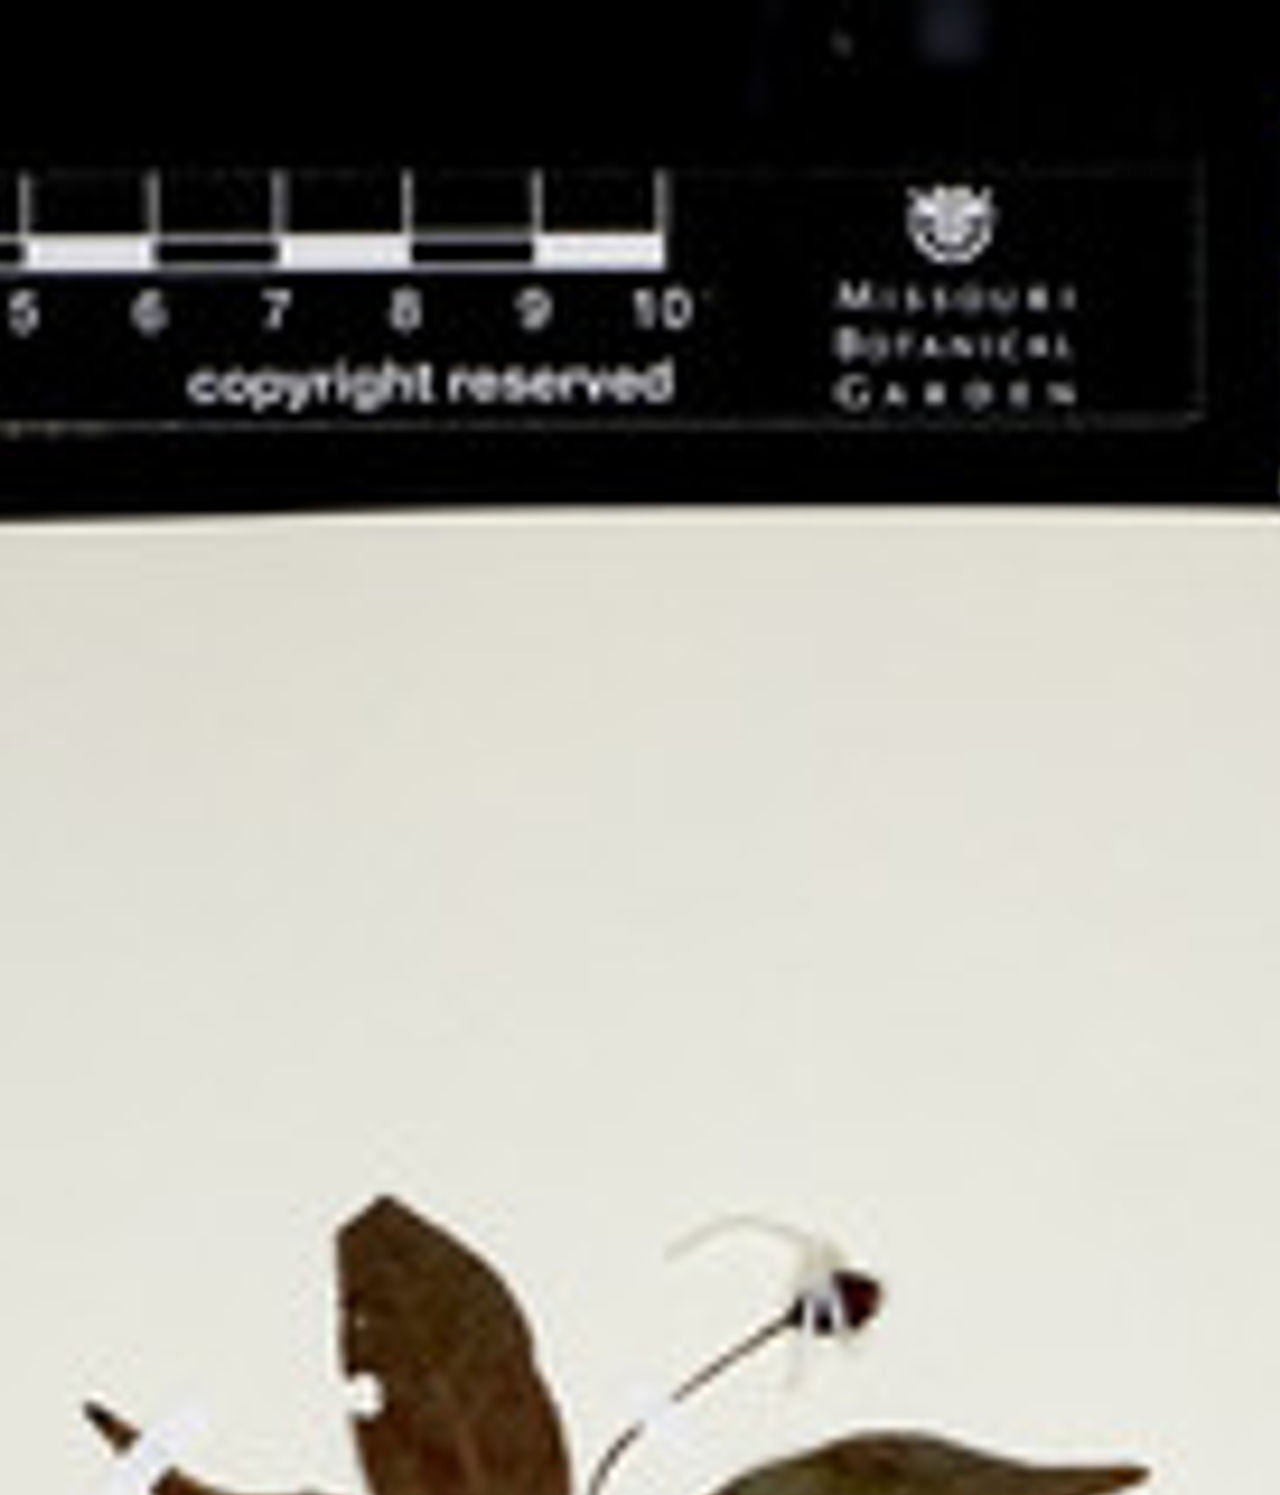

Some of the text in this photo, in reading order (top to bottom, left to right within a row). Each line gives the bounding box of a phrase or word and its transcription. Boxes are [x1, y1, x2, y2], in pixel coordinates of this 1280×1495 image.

[8, 288, 40, 337] 5
[130, 288, 169, 335] 6
[261, 287, 293, 330] 7
[388, 286, 423, 334] 8
[514, 286, 554, 331] 9
[633, 285, 694, 331] 10
[185, 357, 676, 414] copyright reserved
[832, 373, 1077, 412] GARDEN
